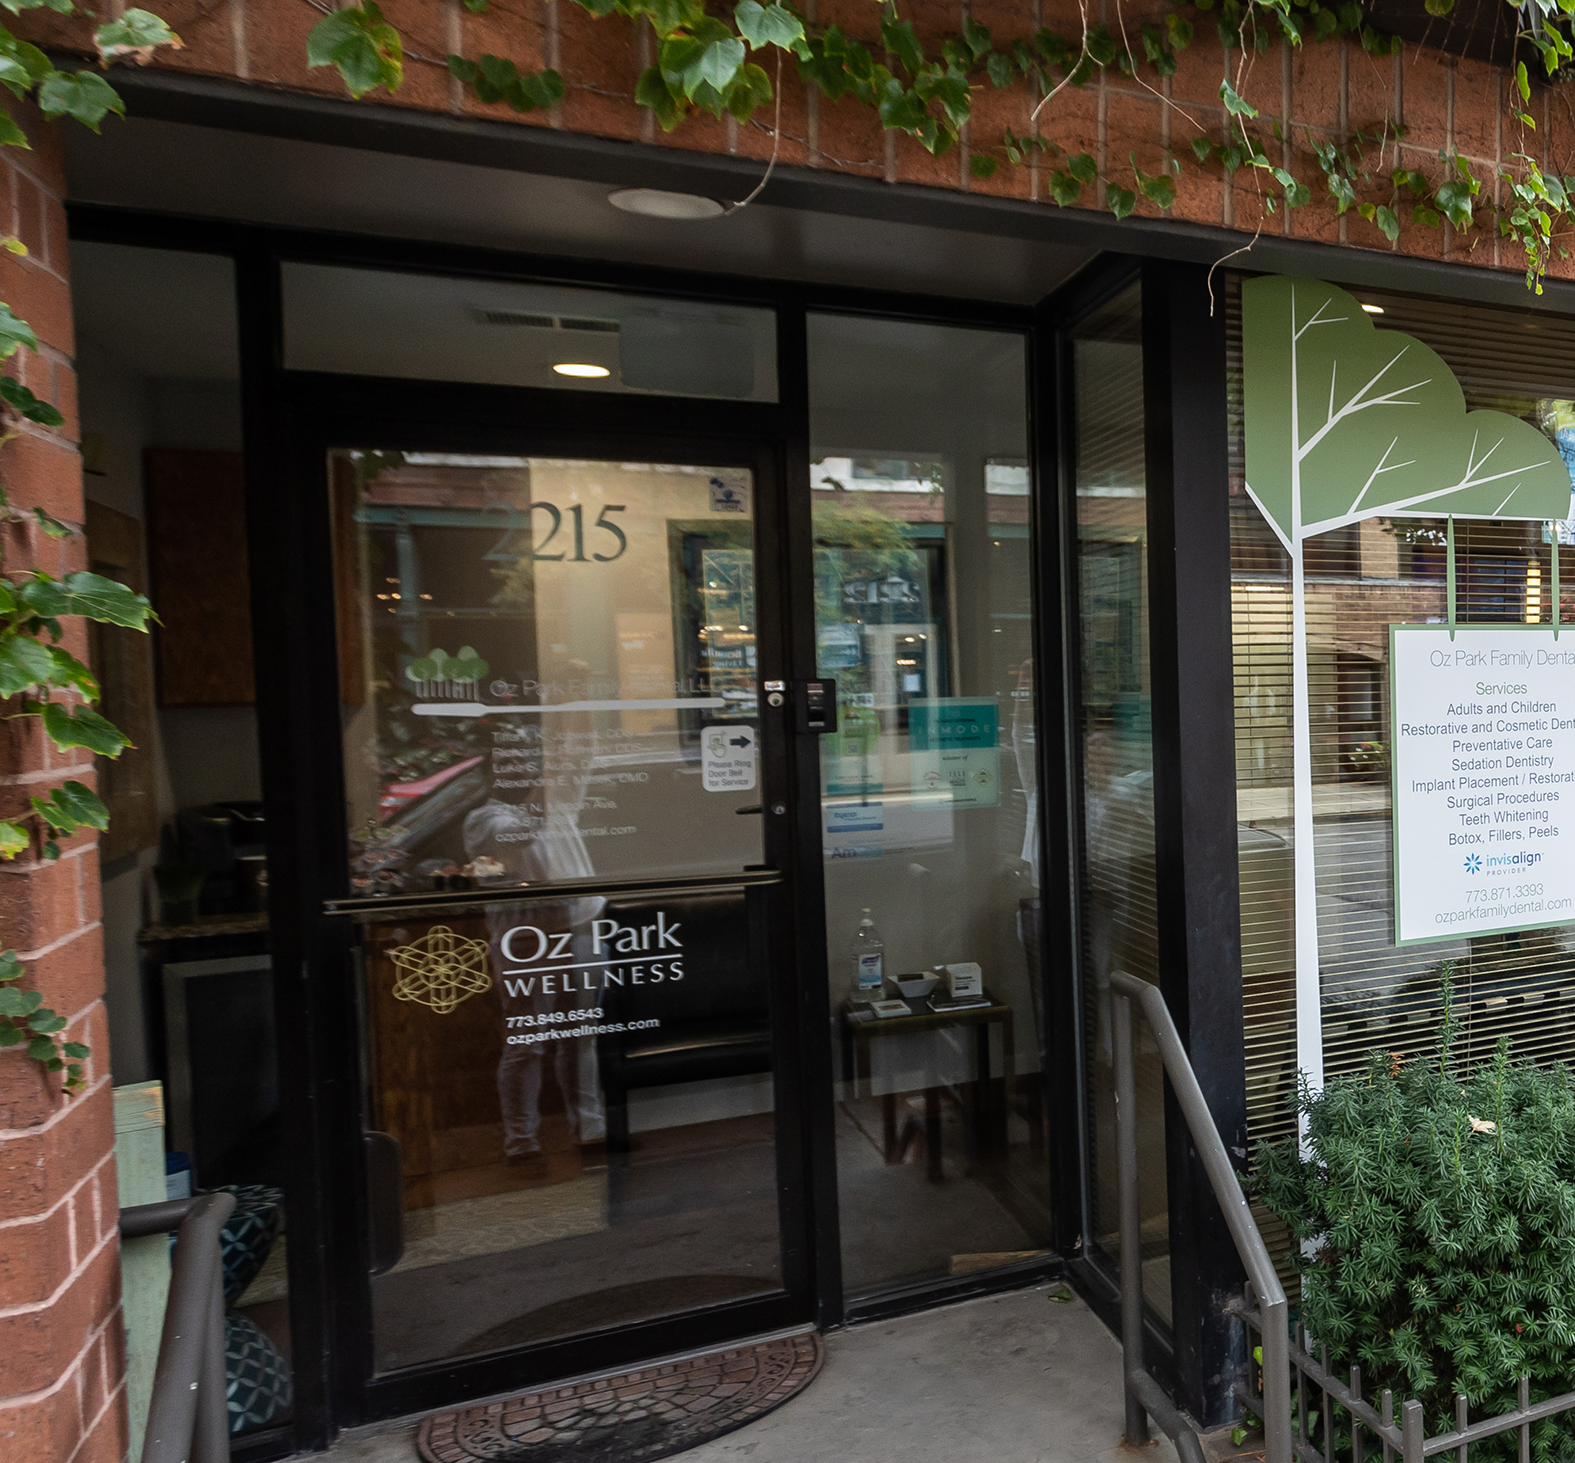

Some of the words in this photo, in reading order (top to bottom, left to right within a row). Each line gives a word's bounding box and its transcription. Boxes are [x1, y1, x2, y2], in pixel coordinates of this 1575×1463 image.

[1430, 650, 1452, 667] Oz
[1455, 650, 1488, 666] Park
[1490, 650, 1533, 669] Family
[490, 680, 518, 697] Oz
[1476, 682, 1528, 695] Services
[1447, 703, 1483, 716] Adults
[1486, 702, 1508, 714] and
[1511, 701, 1556, 713] Children
[1401, 722, 1468, 736] Restorative
[1472, 721, 1492, 732] and
[1496, 718, 1548, 732] Cosmetic
[1452, 739, 1522, 752] Preventative
[1526, 737, 1553, 748] Care
[708, 760, 732, 768] Please
[734, 760, 751, 768] Ring
[1452, 758, 1502, 771] Sedation
[1506, 754, 1554, 768] Dentistry
[619, 772, 648, 783] DMD
[708, 770, 726, 778] Door
[721, 778, 749, 786] Service
[1412, 778, 1456, 794] Implant
[1459, 774, 1519, 790] Placement
[1522, 773, 1526, 785] /
[1447, 794, 1493, 810] Surgical
[1497, 791, 1560, 806] Procedures
[1460, 812, 1490, 826] Teeth
[1494, 808, 1549, 823] Whitening
[1448, 832, 1484, 846] Botox,
[1488, 828, 1525, 842] Fillers,
[1529, 825, 1560, 838] Peels
[1486, 851, 1542, 866] invisalign
[1486, 867, 1526, 876] PROVIDER
[1466, 882, 1544, 904] 773.871.3393
[1435, 896, 1572, 925] ozparkfamilydental.com
[500, 926, 574, 963] Oz
[591, 912, 683, 956] Park
[504, 962, 684, 998] WELLNESS
[505, 1007, 604, 1028] 773.849.6543
[506, 1016, 660, 1046] ozparkwellness.com
